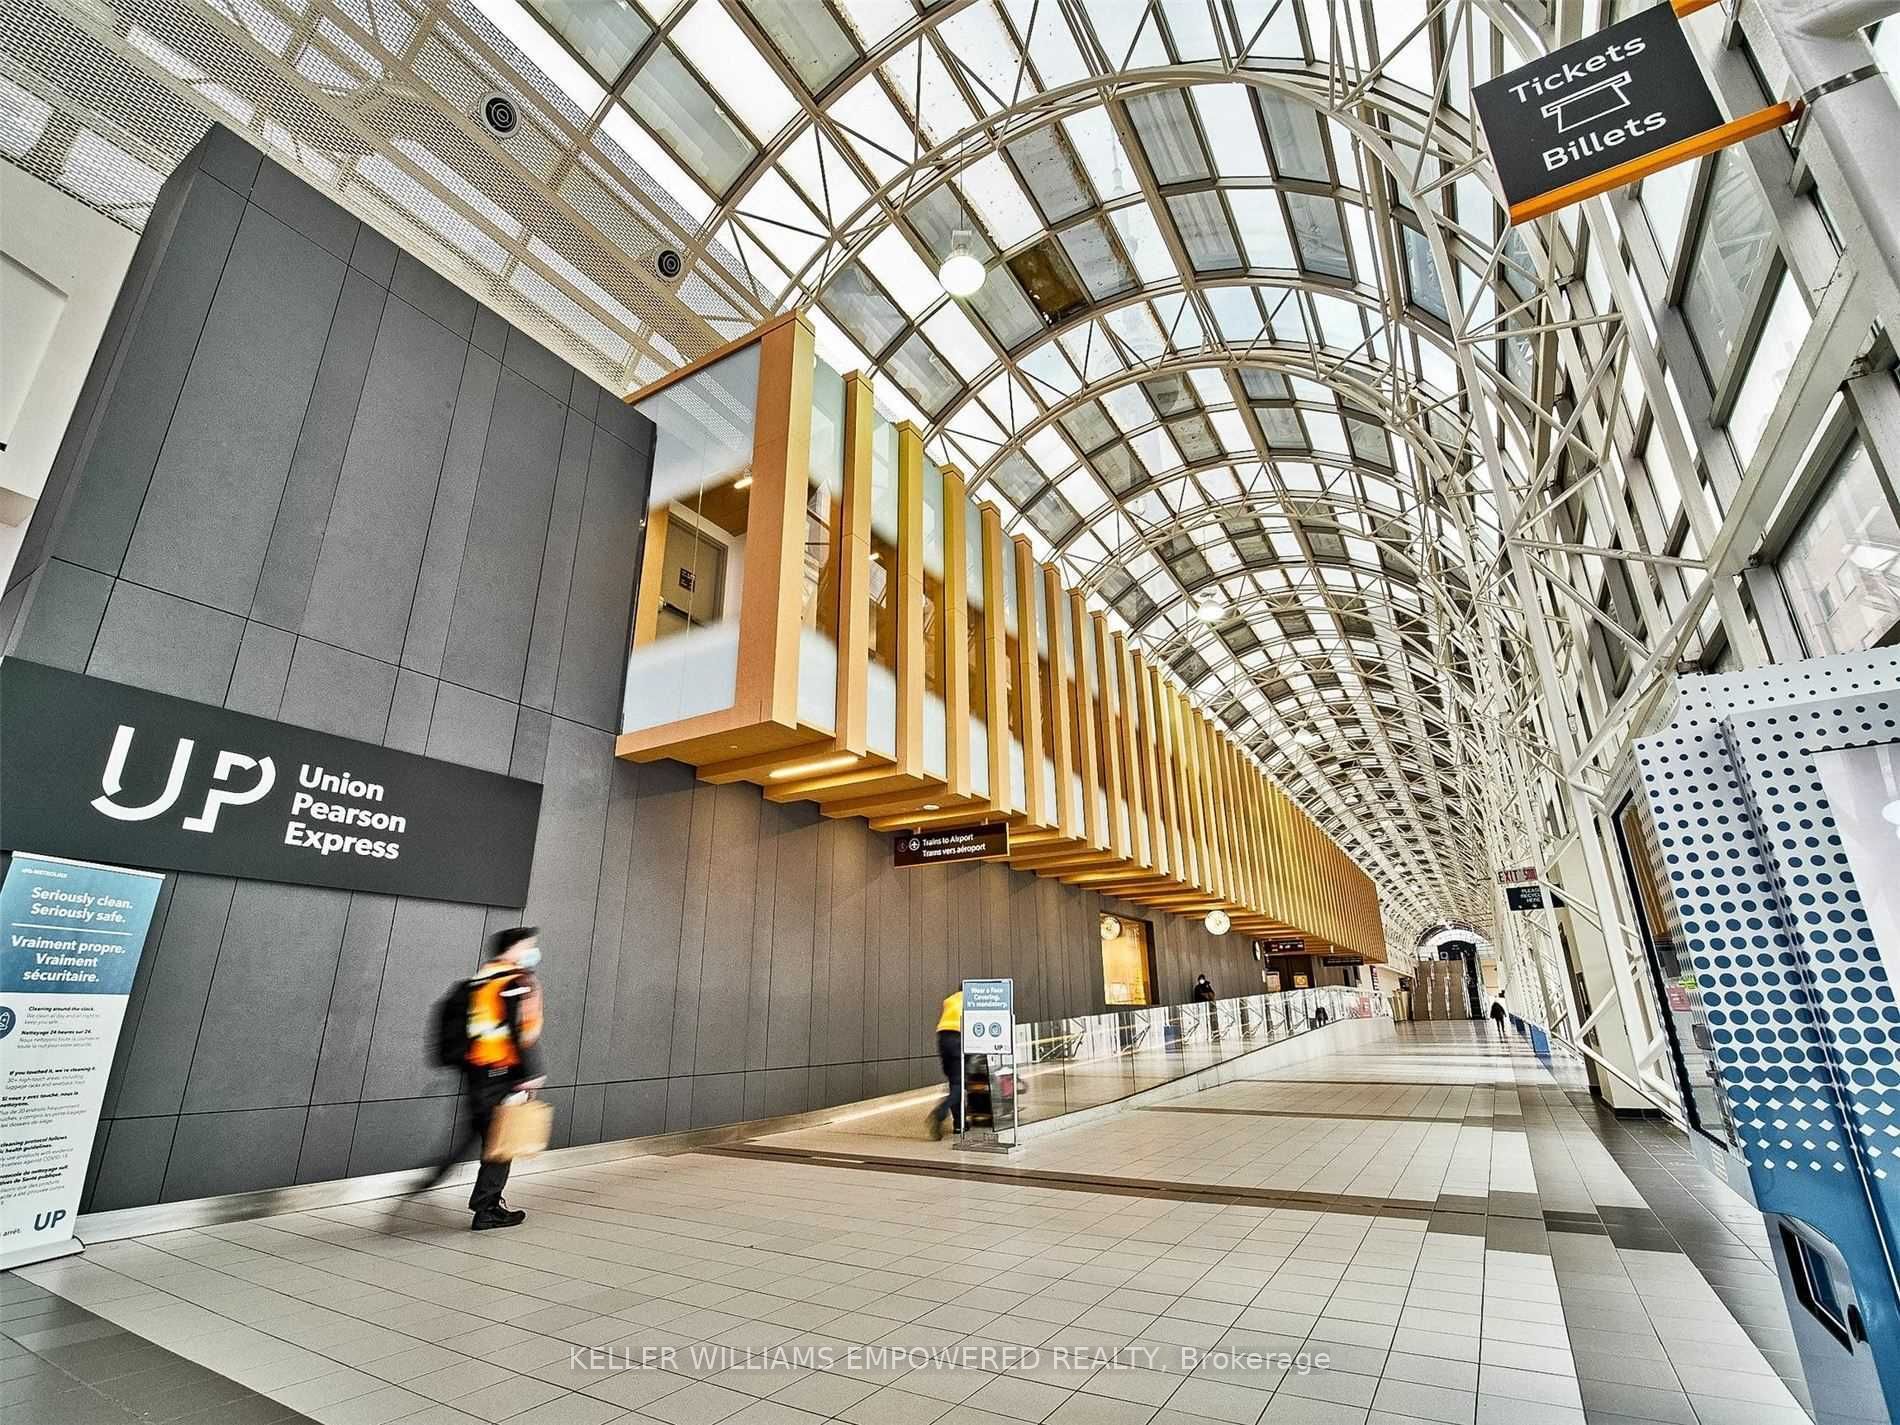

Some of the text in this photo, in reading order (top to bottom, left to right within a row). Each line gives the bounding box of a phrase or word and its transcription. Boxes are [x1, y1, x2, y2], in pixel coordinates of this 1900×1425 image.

[1508, 36, 1647, 104] Tickets
[1541, 110, 1668, 172] Billets
[90, 724, 277, 833] UP
[298, 763, 385, 802] Union
[290, 791, 407, 833] Pearson
[284, 821, 400, 860] Express
[922, 838, 941, 846] Trains
[950, 834, 974, 843] Airport
[922, 848, 941, 857] Trains
[956, 843, 986, 853] aéroport
[1498, 870, 1519, 883] EXIT
[31, 886, 133, 910] Seriously clean.
[30, 903, 126, 924] Seriously safe.
[11, 934, 126, 956] Vraiment propre.
[35, 952, 98, 968] Vraiment
[22, 968, 100, 983] sécuritaire.
[34, 1209, 67, 1231] UP
